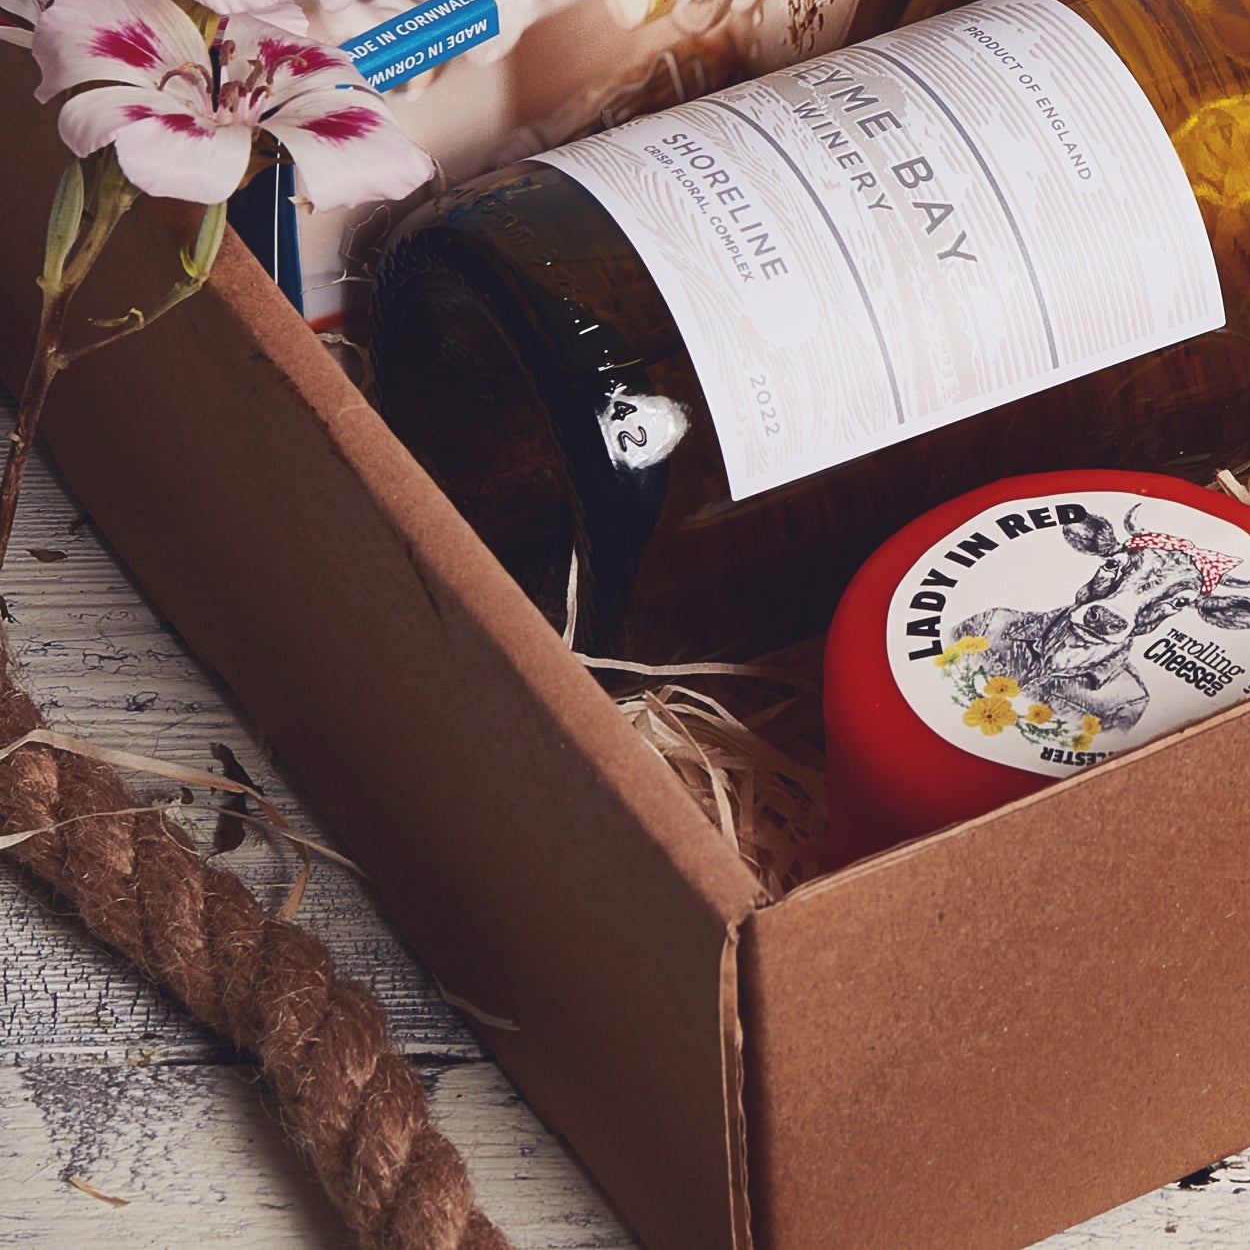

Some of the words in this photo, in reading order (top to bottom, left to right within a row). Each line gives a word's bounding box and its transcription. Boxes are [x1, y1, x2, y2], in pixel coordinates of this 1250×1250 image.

[348, 40, 378, 62] ADE
[375, 30, 397, 46] IN
[427, 41, 444, 58] IN
[447, 19, 488, 50] MADE
[963, 26, 1023, 70] PRODUCT
[1018, 74, 1042, 93] OF
[1035, 97, 1092, 180] ENGLAND
[791, 64, 903, 139] LYME
[890, 155, 978, 263] BAY
[792, 101, 894, 211] WINERY
[644, 144, 673, 172] CRISP,
[671, 167, 708, 214] FLORAL,
[709, 215, 756, 283] COMPLEX
[662, 133, 789, 281] SHORELINE
[750, 373, 781, 438] 2022
[906, 568, 958, 661] LADY
[943, 532, 1000, 568] IN
[995, 503, 1088, 540] RED
[1143, 638, 1216, 692] Cheese
[1166, 628, 1187, 644] THE
[1180, 637, 1246, 684] rolling
